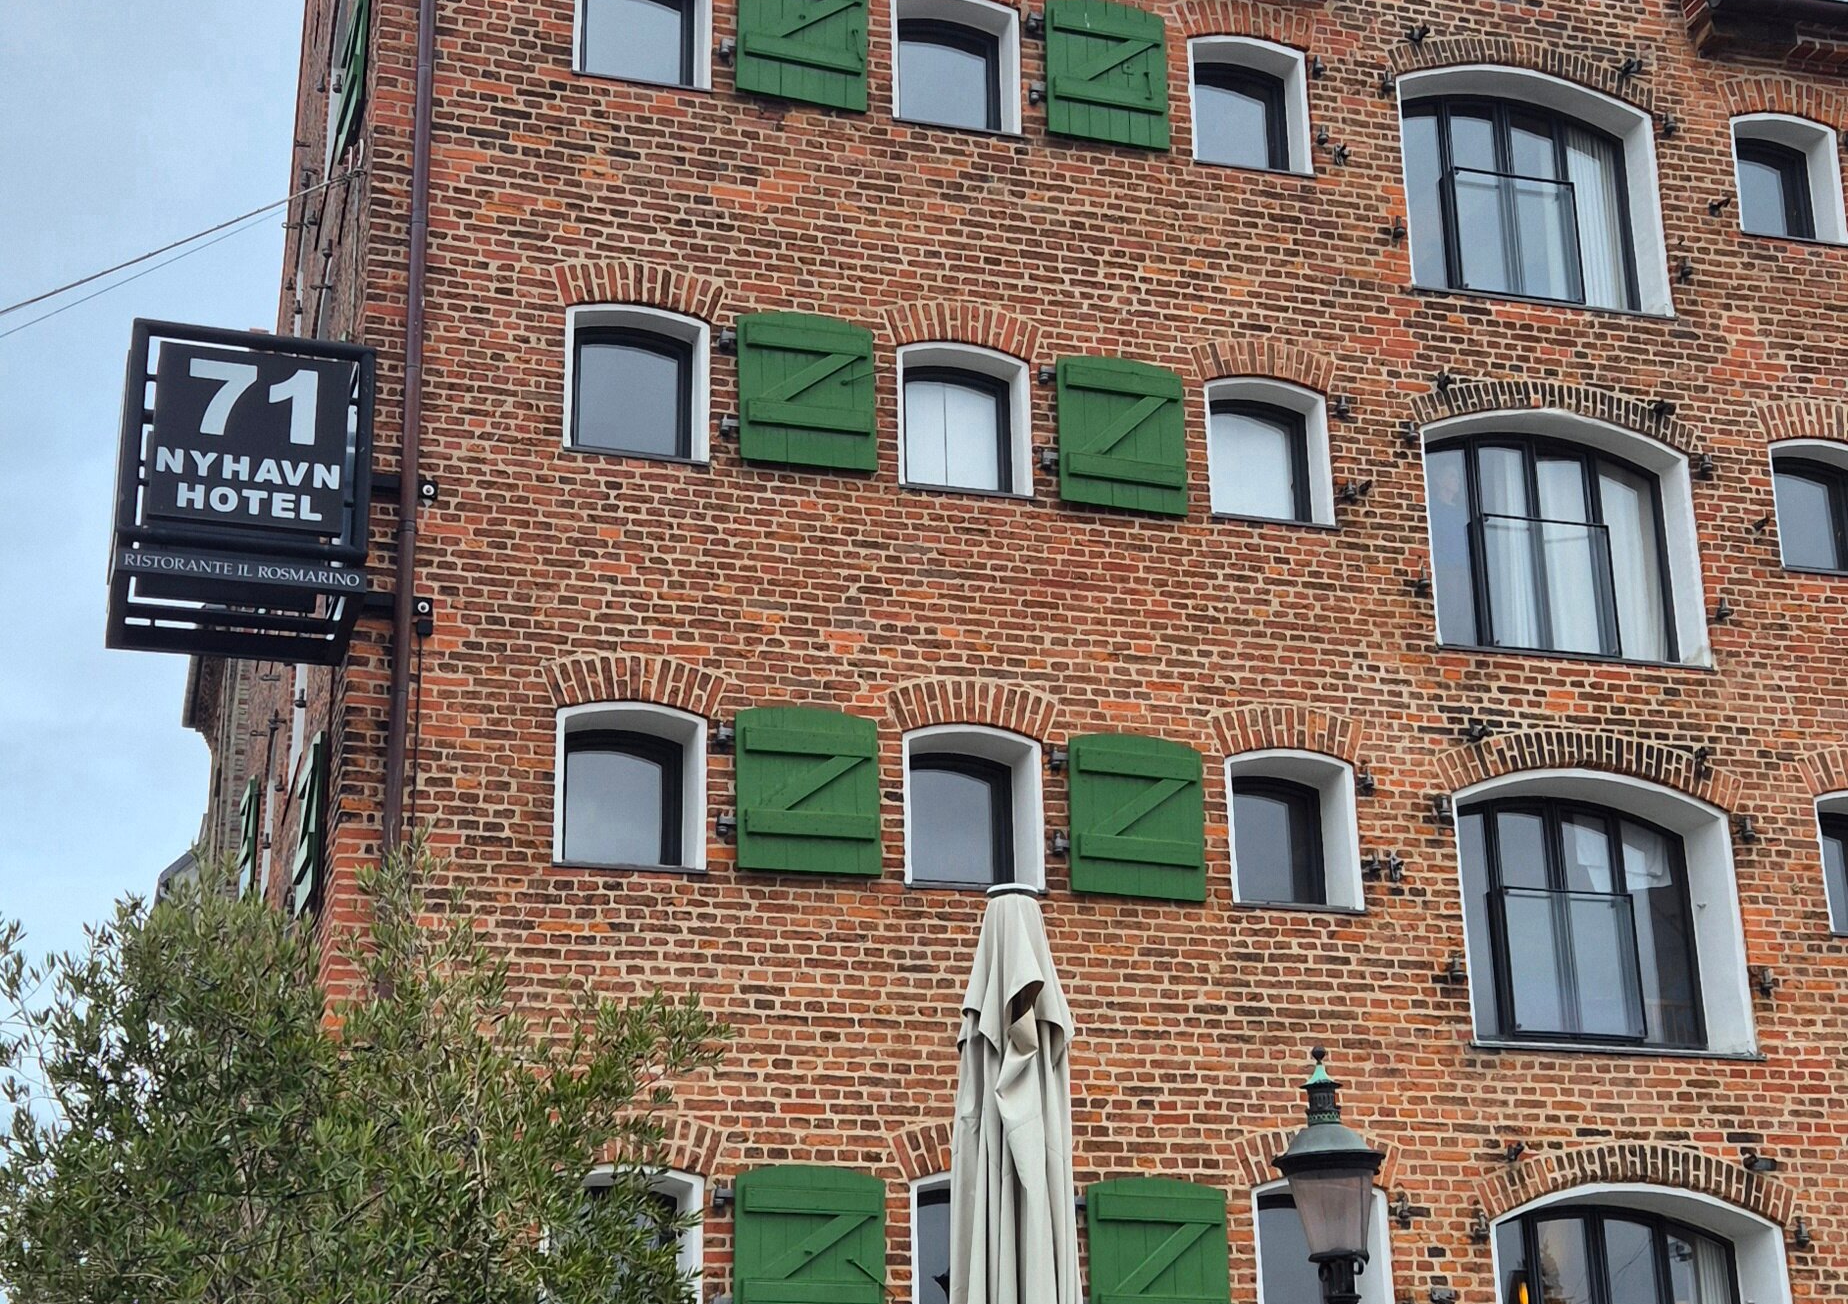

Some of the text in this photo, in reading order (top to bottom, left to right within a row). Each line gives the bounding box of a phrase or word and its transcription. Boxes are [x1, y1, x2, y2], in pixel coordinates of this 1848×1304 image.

[189, 357, 319, 445] 71
[155, 446, 341, 490] NYHAVN
[176, 482, 323, 521] HOTEL
[124, 553, 360, 587] RISTORANTE IL ROSMARINO
